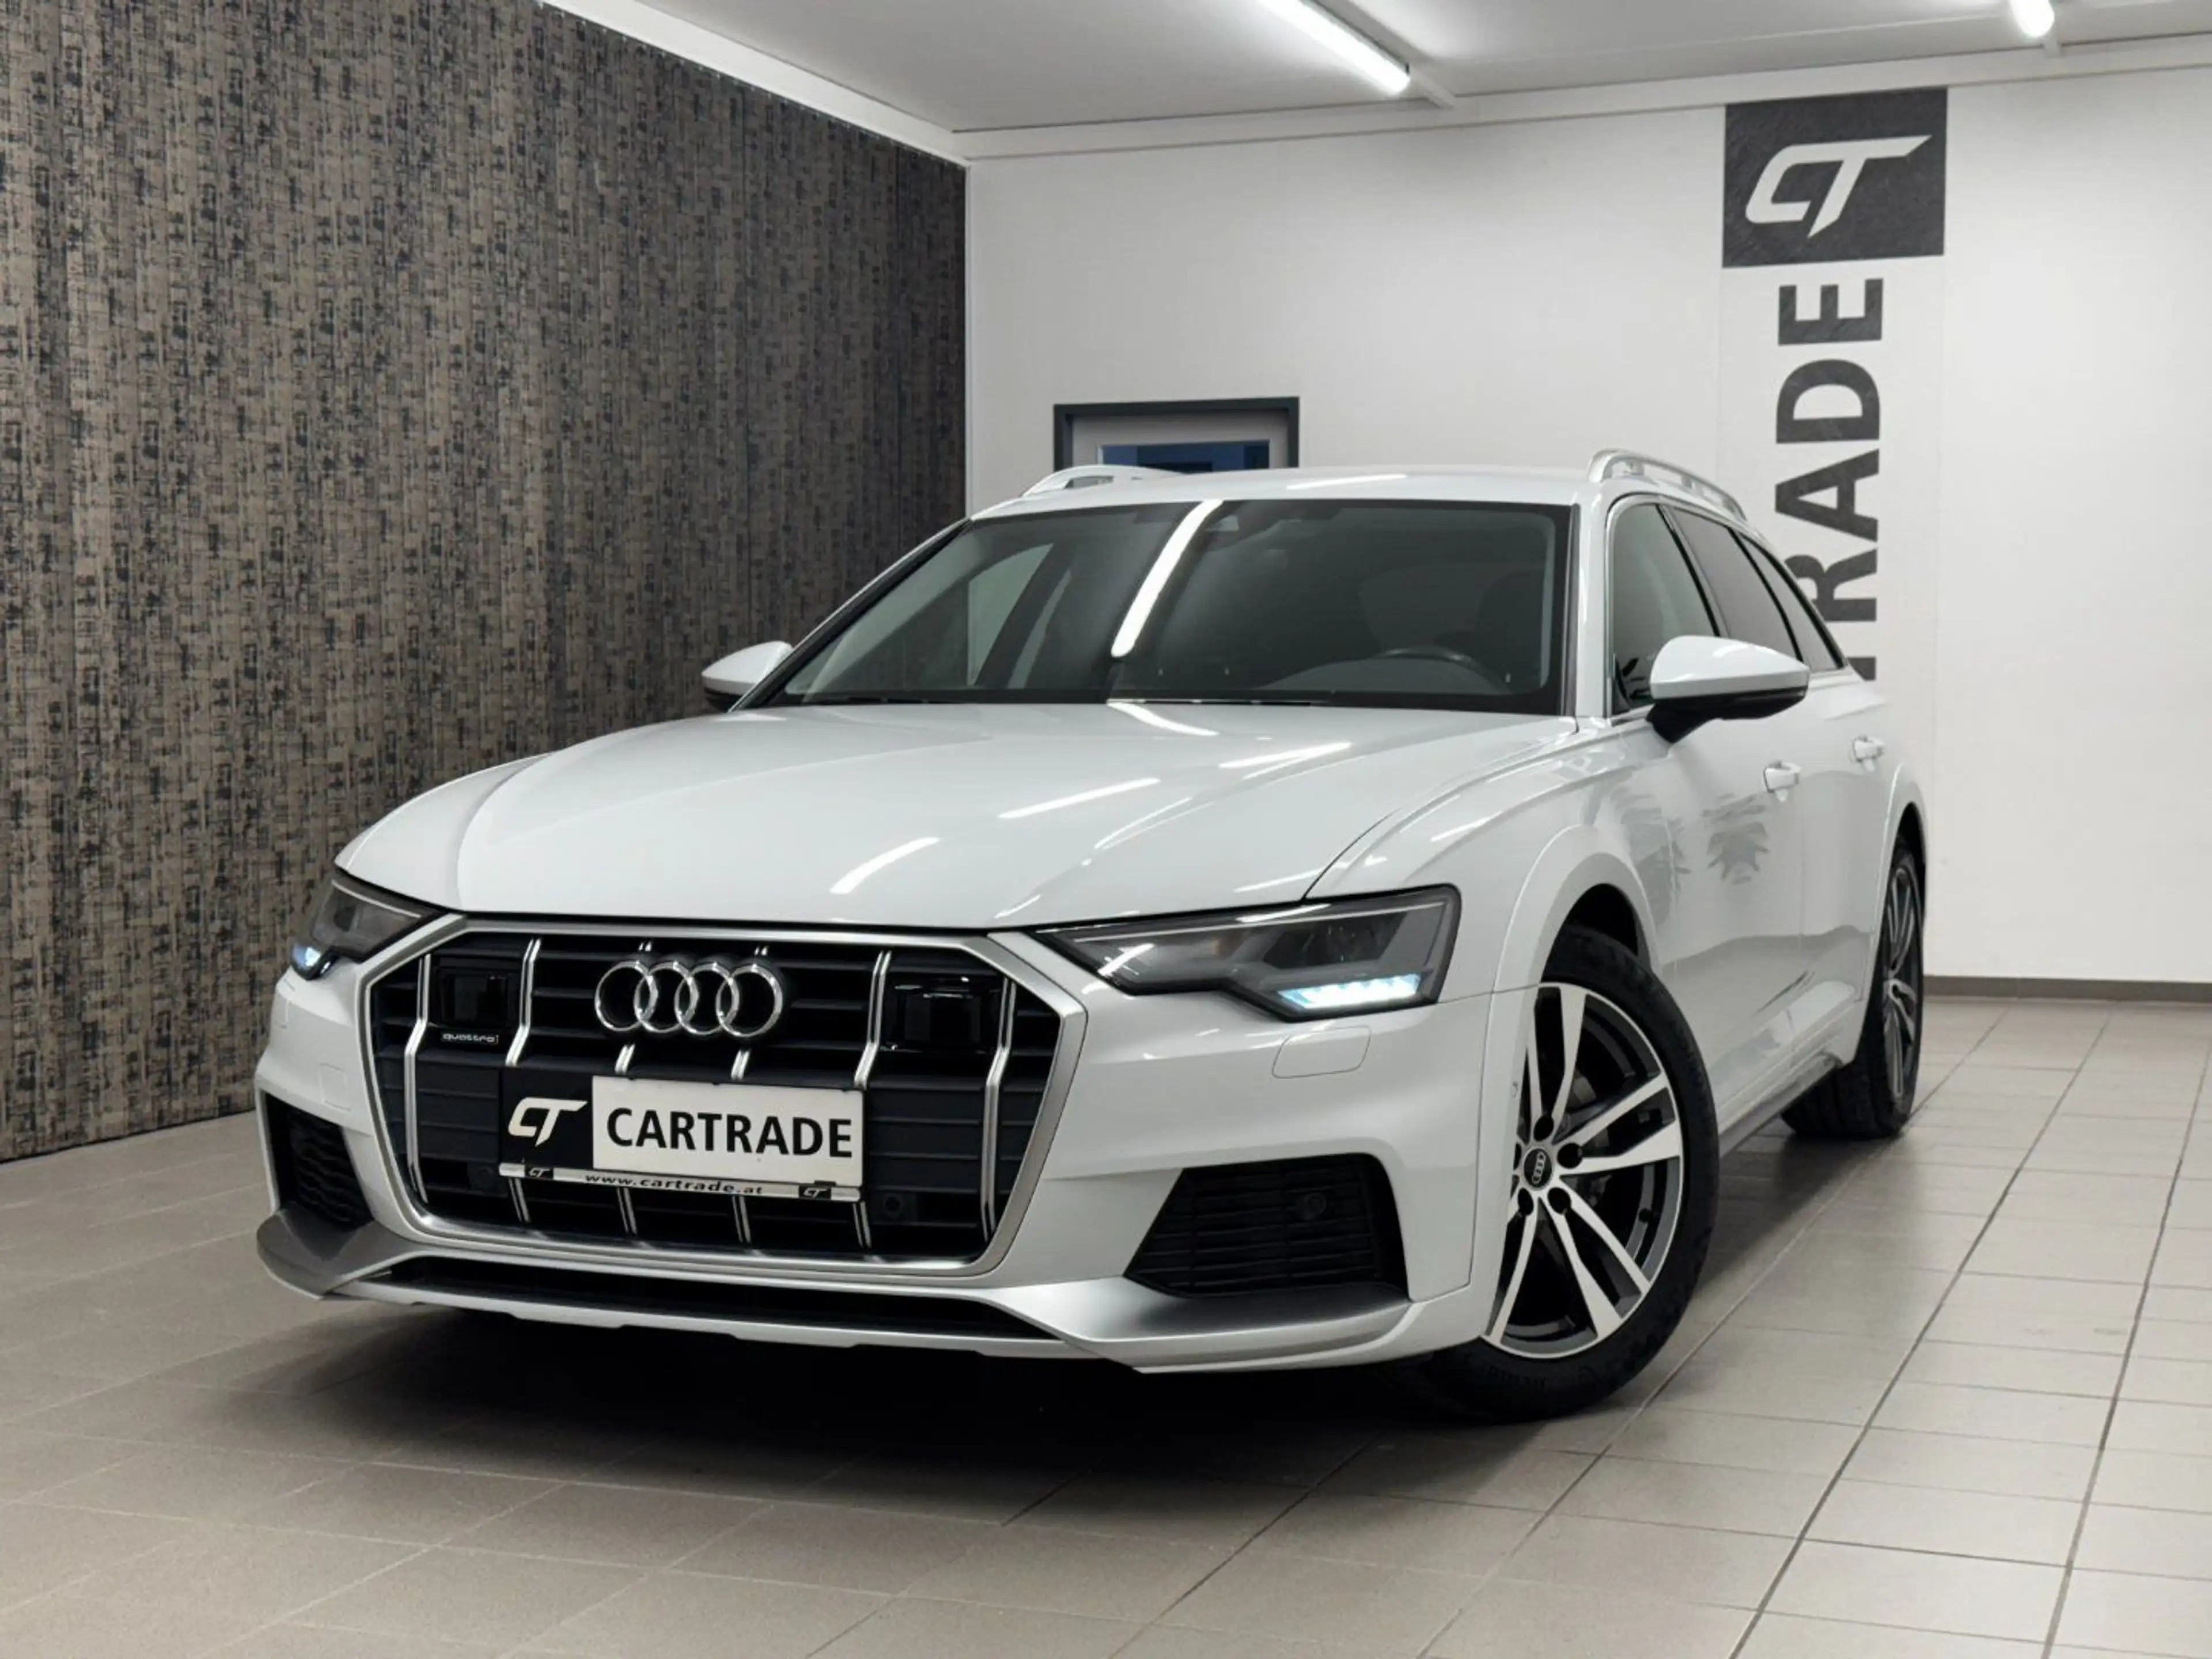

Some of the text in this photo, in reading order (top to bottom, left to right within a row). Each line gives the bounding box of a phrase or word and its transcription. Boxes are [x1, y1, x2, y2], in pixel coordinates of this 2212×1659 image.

[1775, 278, 1884, 681] RADE
[442, 1033, 495, 1043] quattro
[607, 1107, 853, 1158] CARTRADE
[584, 1173, 763, 1195] www.cartrade.at
